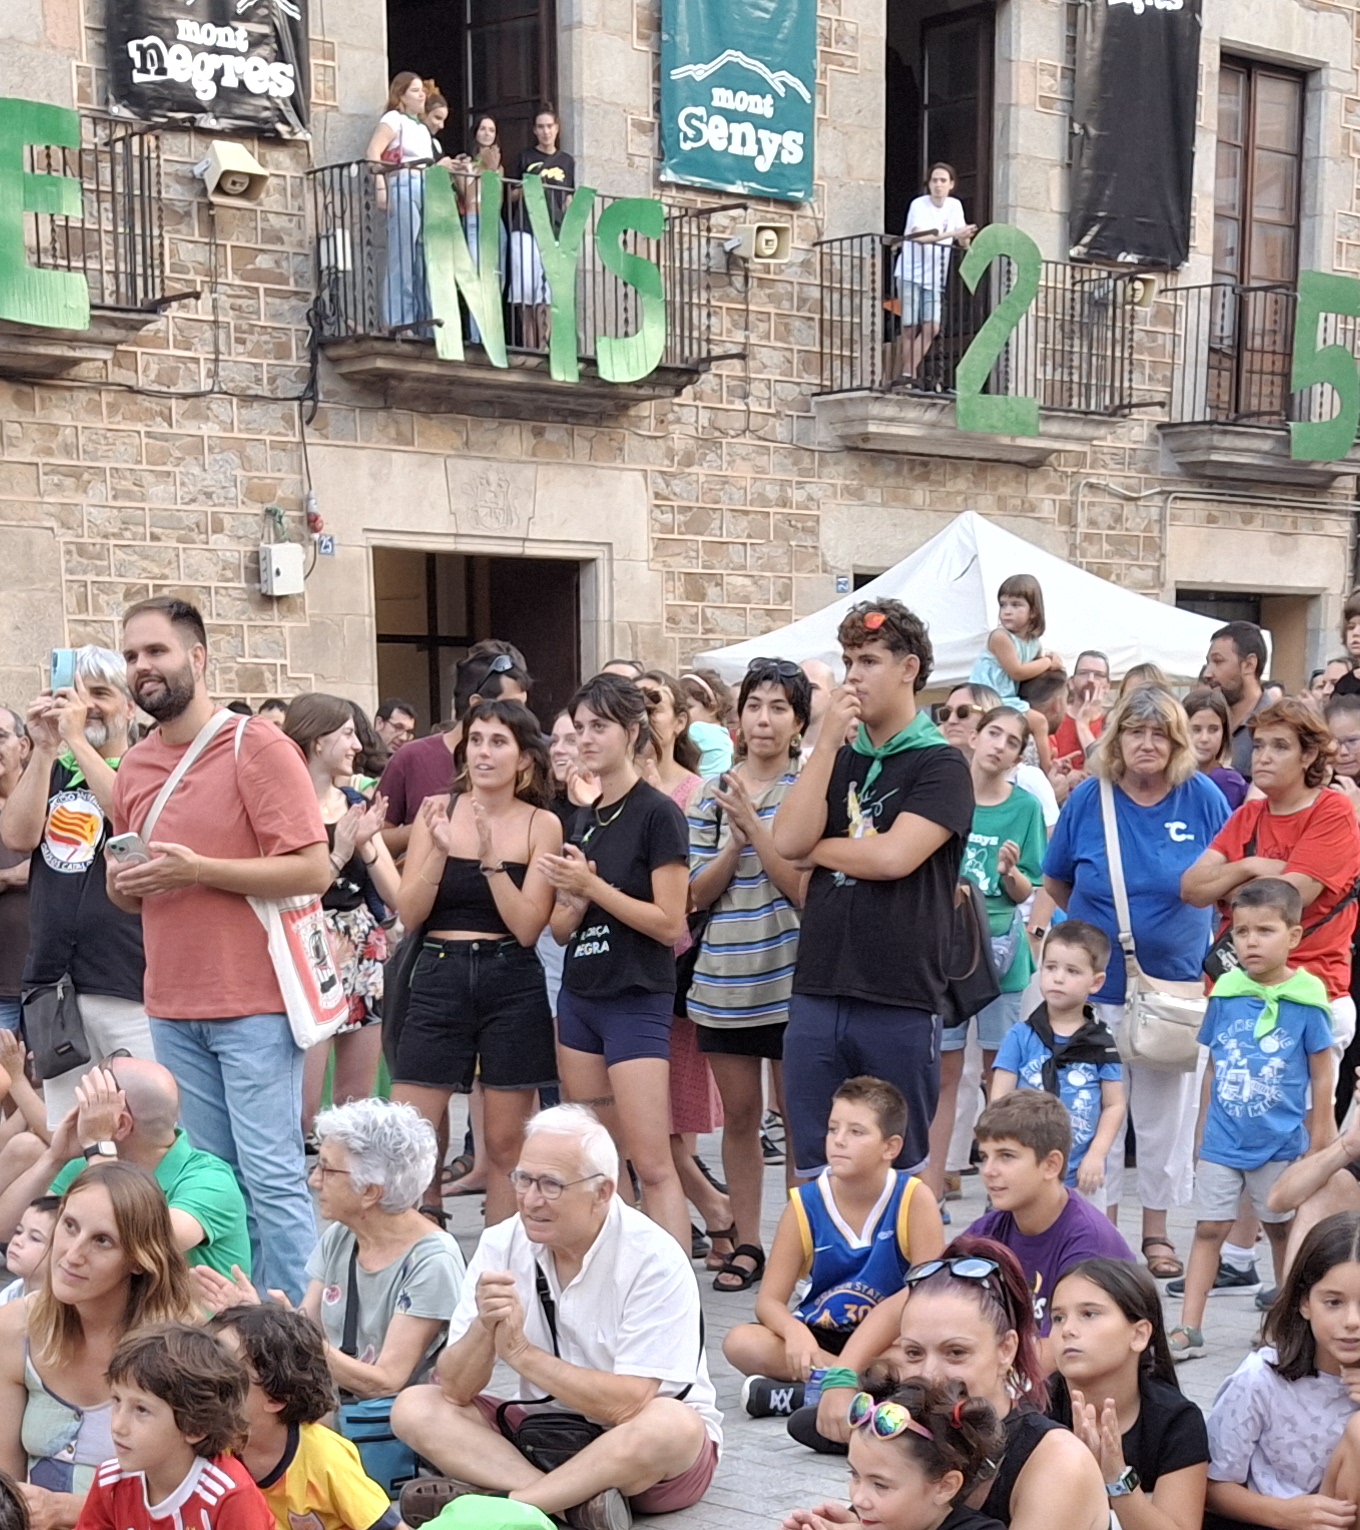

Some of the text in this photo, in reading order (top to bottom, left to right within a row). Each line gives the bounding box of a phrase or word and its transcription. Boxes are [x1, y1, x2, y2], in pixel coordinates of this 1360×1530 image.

[175, 19, 249, 53] mont
[711, 87, 774, 119] mont
[677, 105, 804, 173] Senys
